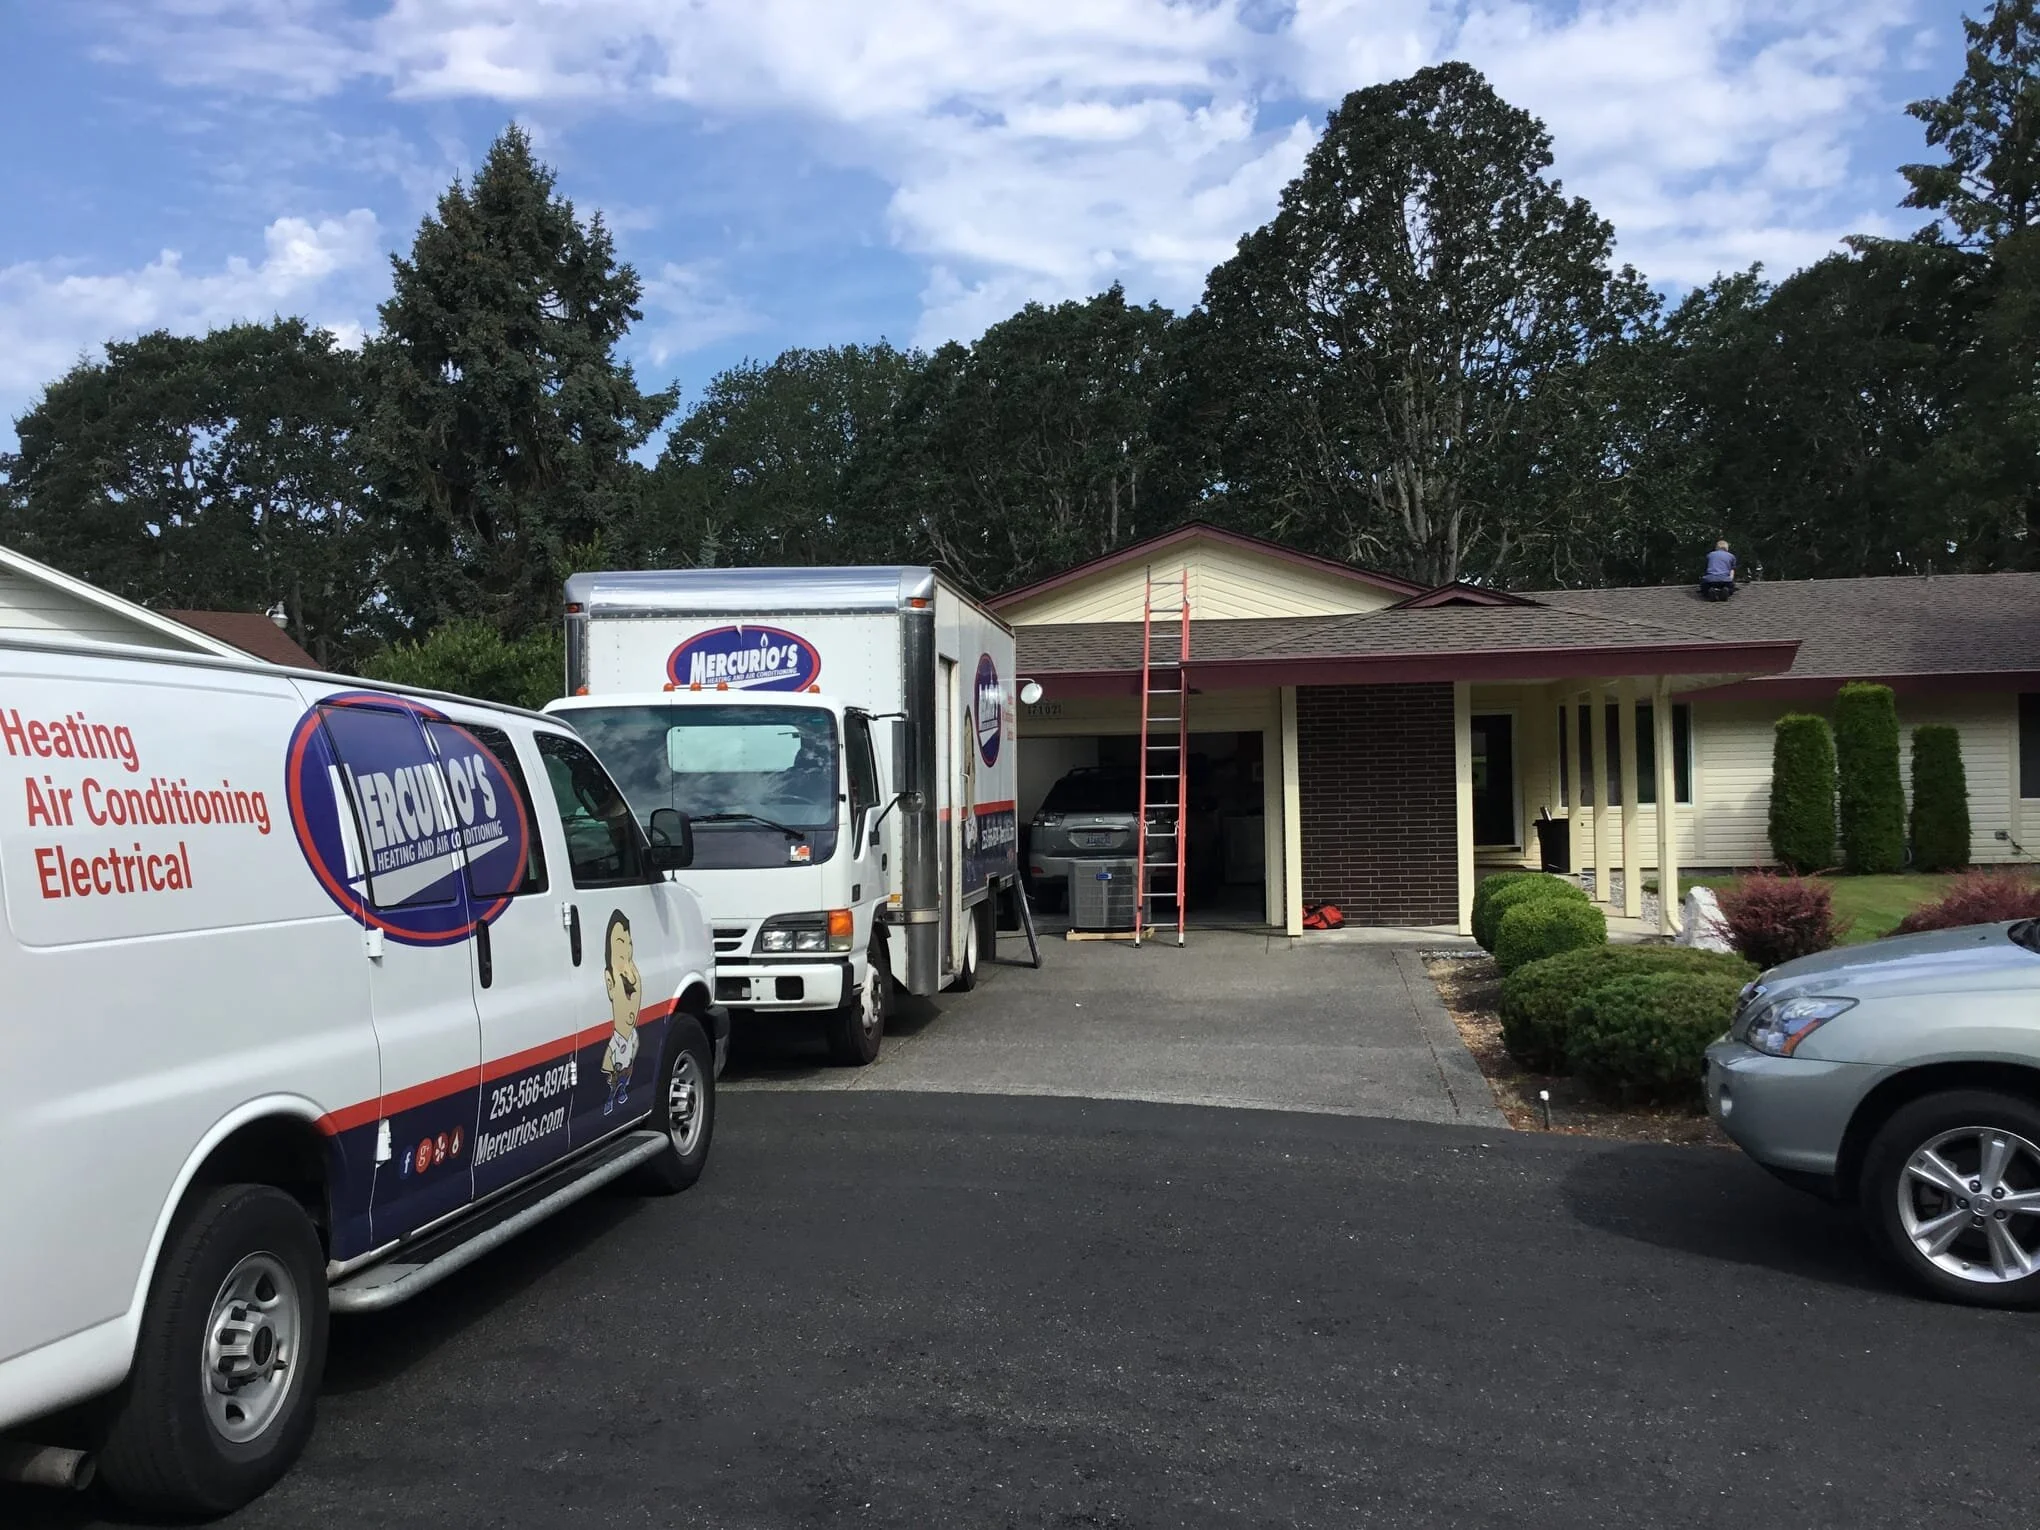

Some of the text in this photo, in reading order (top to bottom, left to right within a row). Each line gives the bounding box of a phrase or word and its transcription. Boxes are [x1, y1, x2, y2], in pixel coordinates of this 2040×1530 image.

[691, 644, 798, 684] MERCURIO'S
[707, 667, 798, 684] HEATING AND AIR CONDITIONING
[0, 709, 140, 773] Heating
[25, 776, 272, 835] Air Conditioning
[328, 754, 497, 879] MERCURIO'S
[34, 842, 193, 899] Electrical
[377, 844, 416, 872] HEATING
[418, 839, 434, 860] AND
[436, 835, 450, 856] AIR
[490, 1063, 571, 1121] 253-566-8974
[474, 1106, 565, 1167] Mercurios.com
